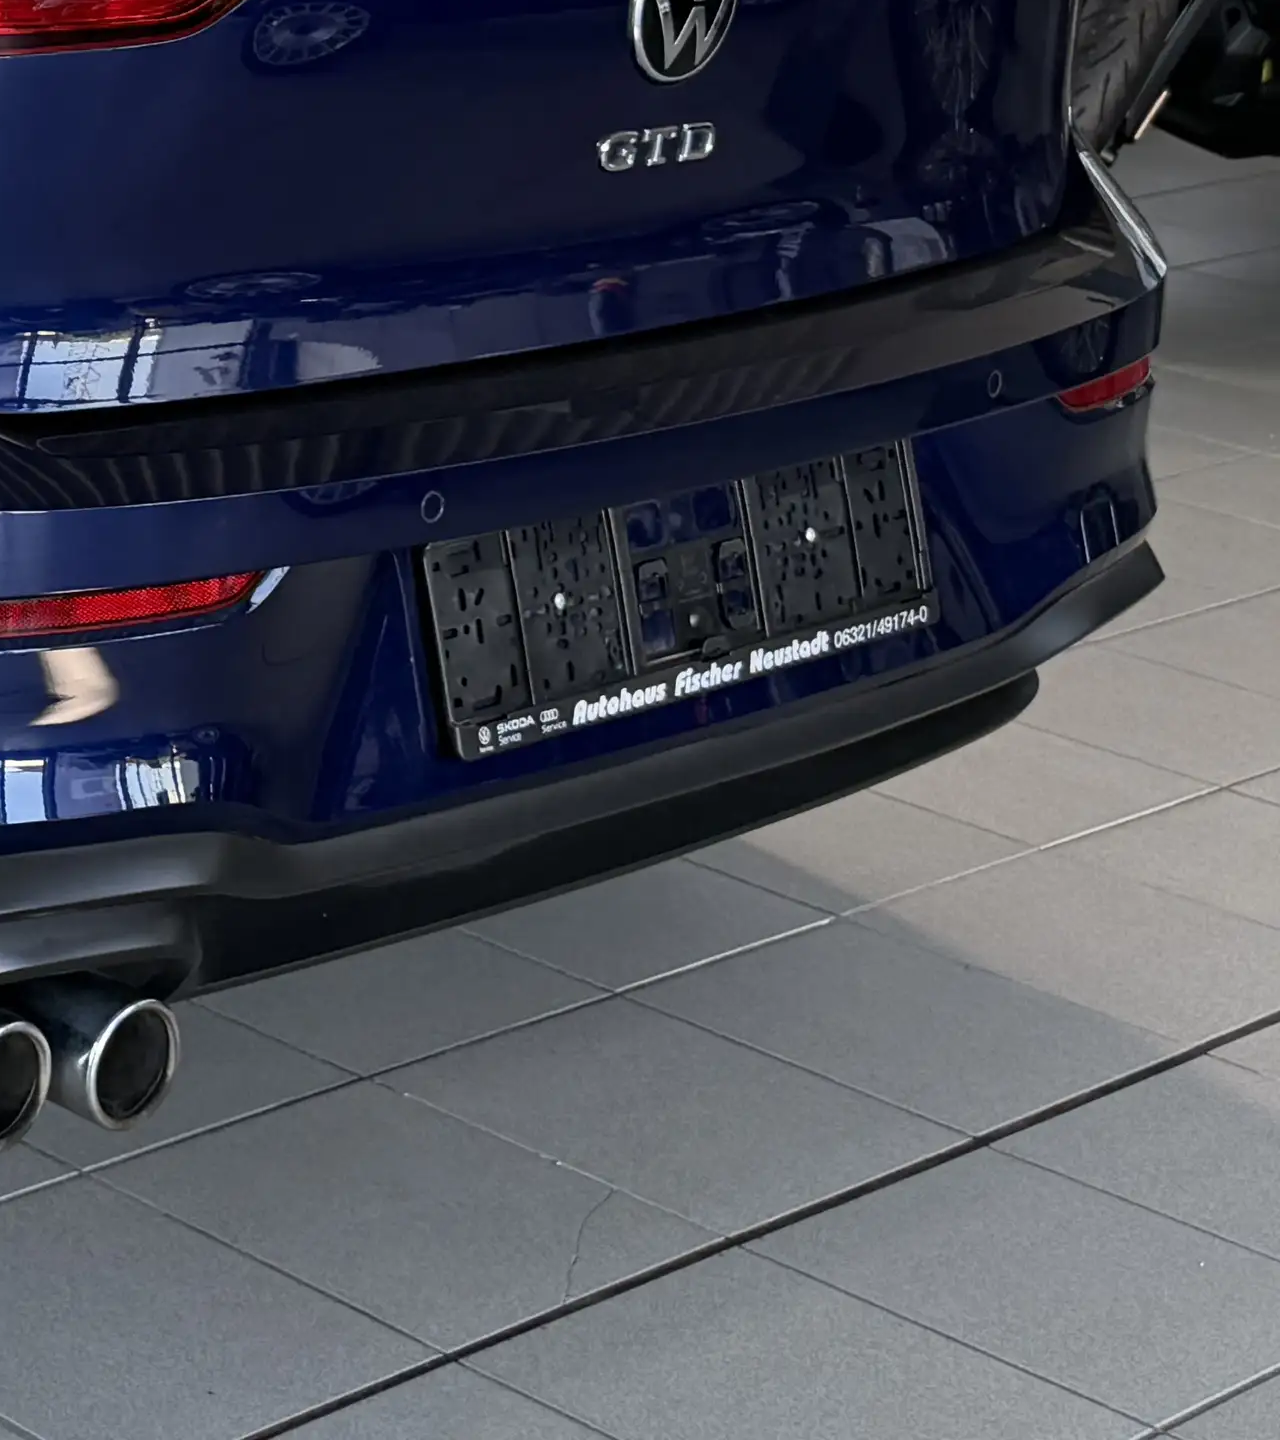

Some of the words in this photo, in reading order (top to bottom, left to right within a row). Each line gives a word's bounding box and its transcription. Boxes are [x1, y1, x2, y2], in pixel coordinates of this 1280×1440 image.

[597, 122, 716, 171] GTD
[573, 683, 667, 726] Autohaus
[675, 661, 742, 697] Fischer
[750, 630, 829, 674] Neustadt
[834, 606, 928, 648] 06321/49174-0
[541, 720, 567, 734] Service
